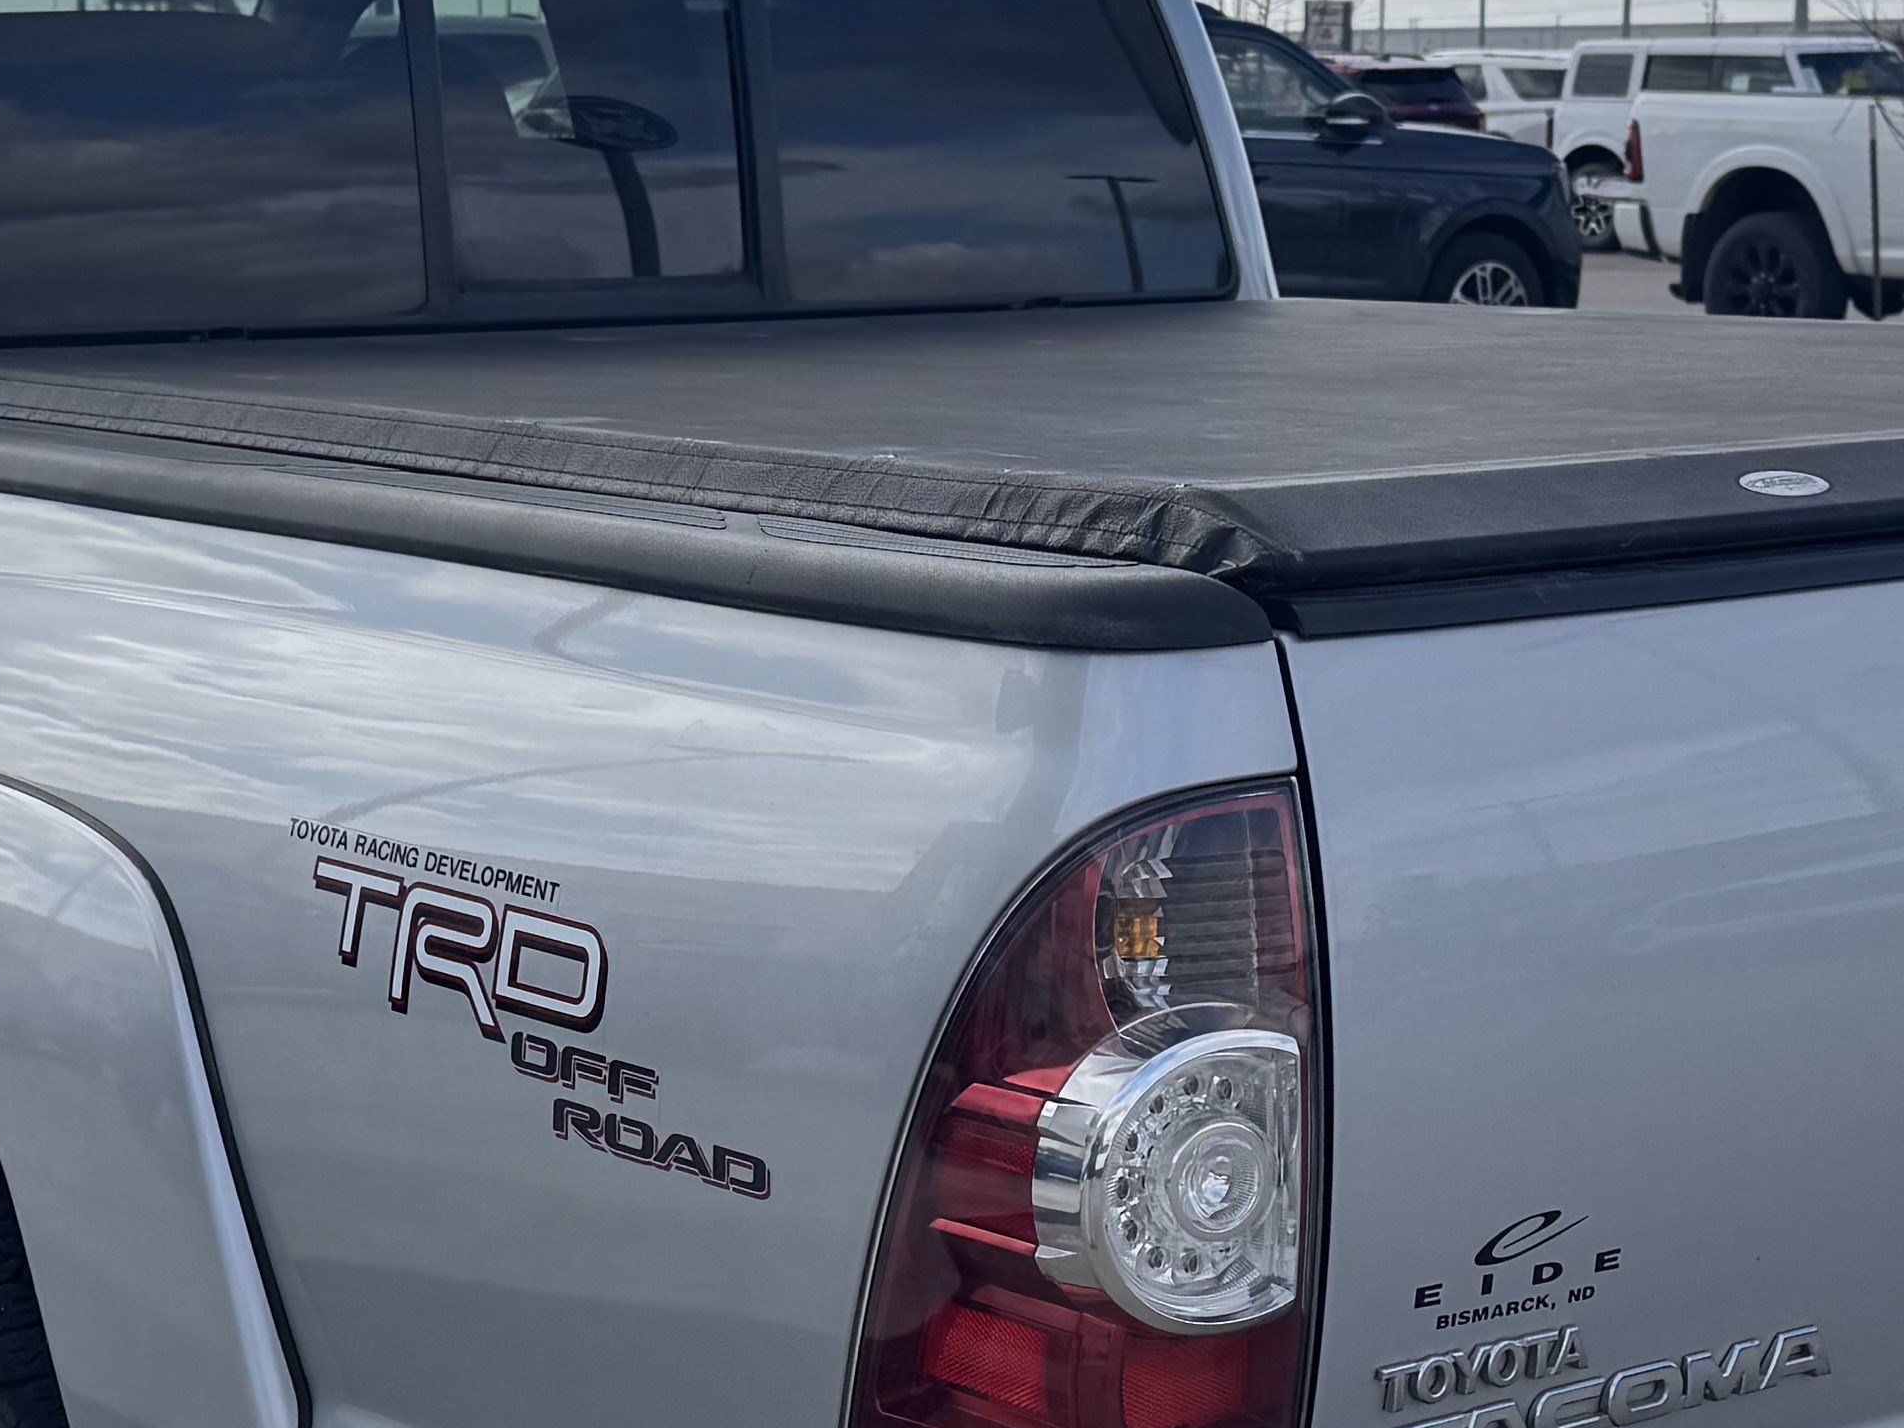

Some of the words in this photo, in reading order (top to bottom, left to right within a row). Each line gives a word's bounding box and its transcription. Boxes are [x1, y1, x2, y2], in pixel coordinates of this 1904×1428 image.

[289, 816, 348, 852] TOYOTA
[354, 833, 419, 869] RACING
[423, 850, 561, 904] DEVELOPMENT
[313, 855, 609, 1043] TRD
[509, 1030, 660, 1104] OFF
[551, 1097, 772, 1200] ROAD
[1413, 1248, 1622, 1309] EIDE
[1436, 1291, 1557, 1330] BISMARCK,
[1567, 1285, 1596, 1305] ND
[1375, 1324, 1590, 1413] TOYOTA
